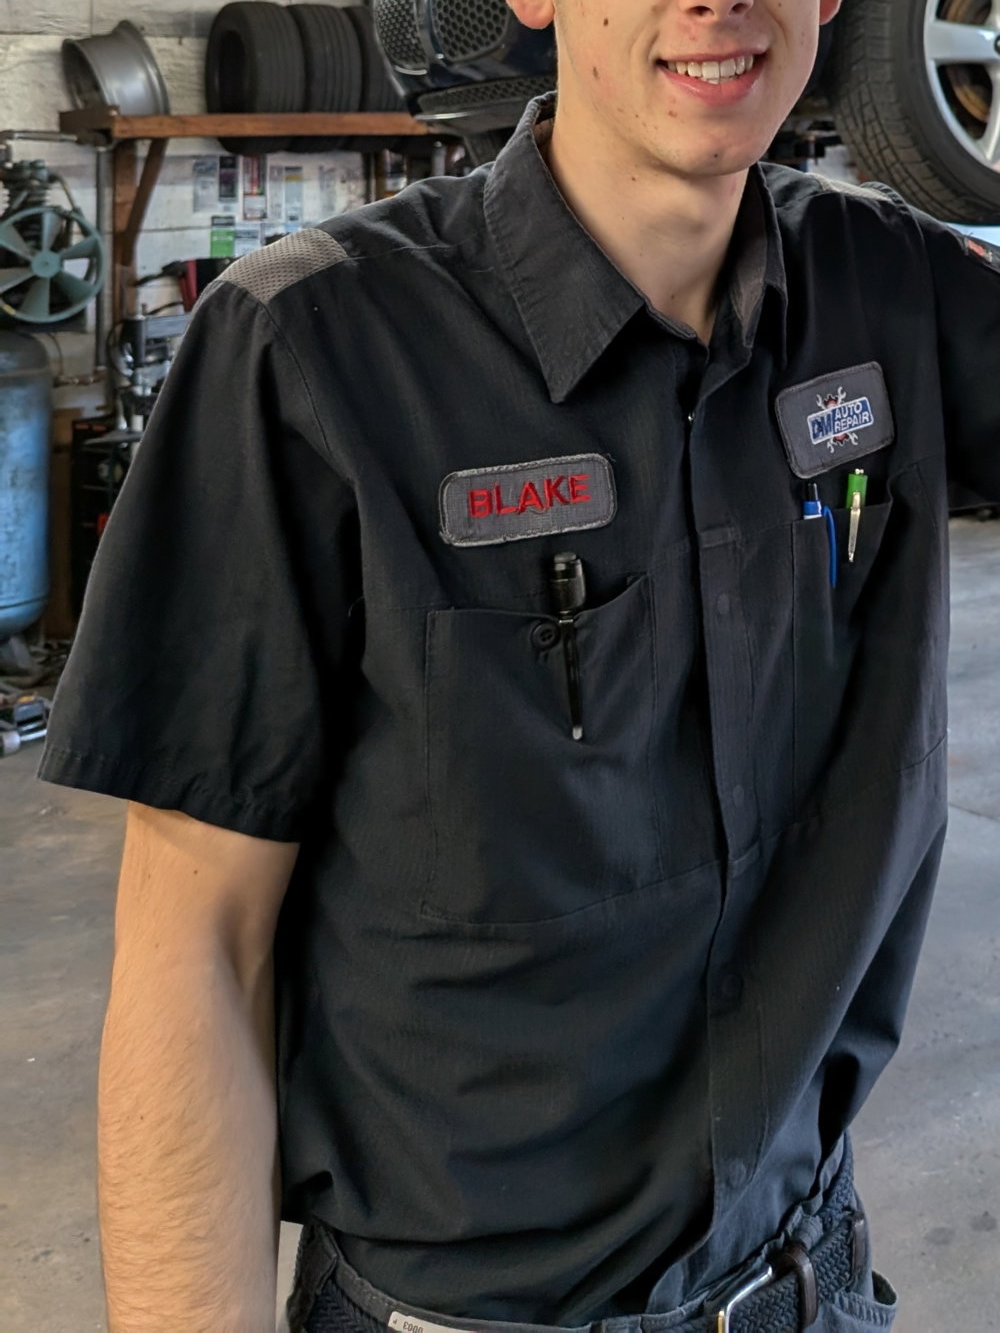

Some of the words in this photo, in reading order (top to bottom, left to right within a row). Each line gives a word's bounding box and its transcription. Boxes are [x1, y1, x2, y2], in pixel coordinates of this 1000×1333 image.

[834, 402, 863, 421] AUTO
[834, 411, 870, 433] REPAIR
[469, 474, 592, 519] BLAKE
